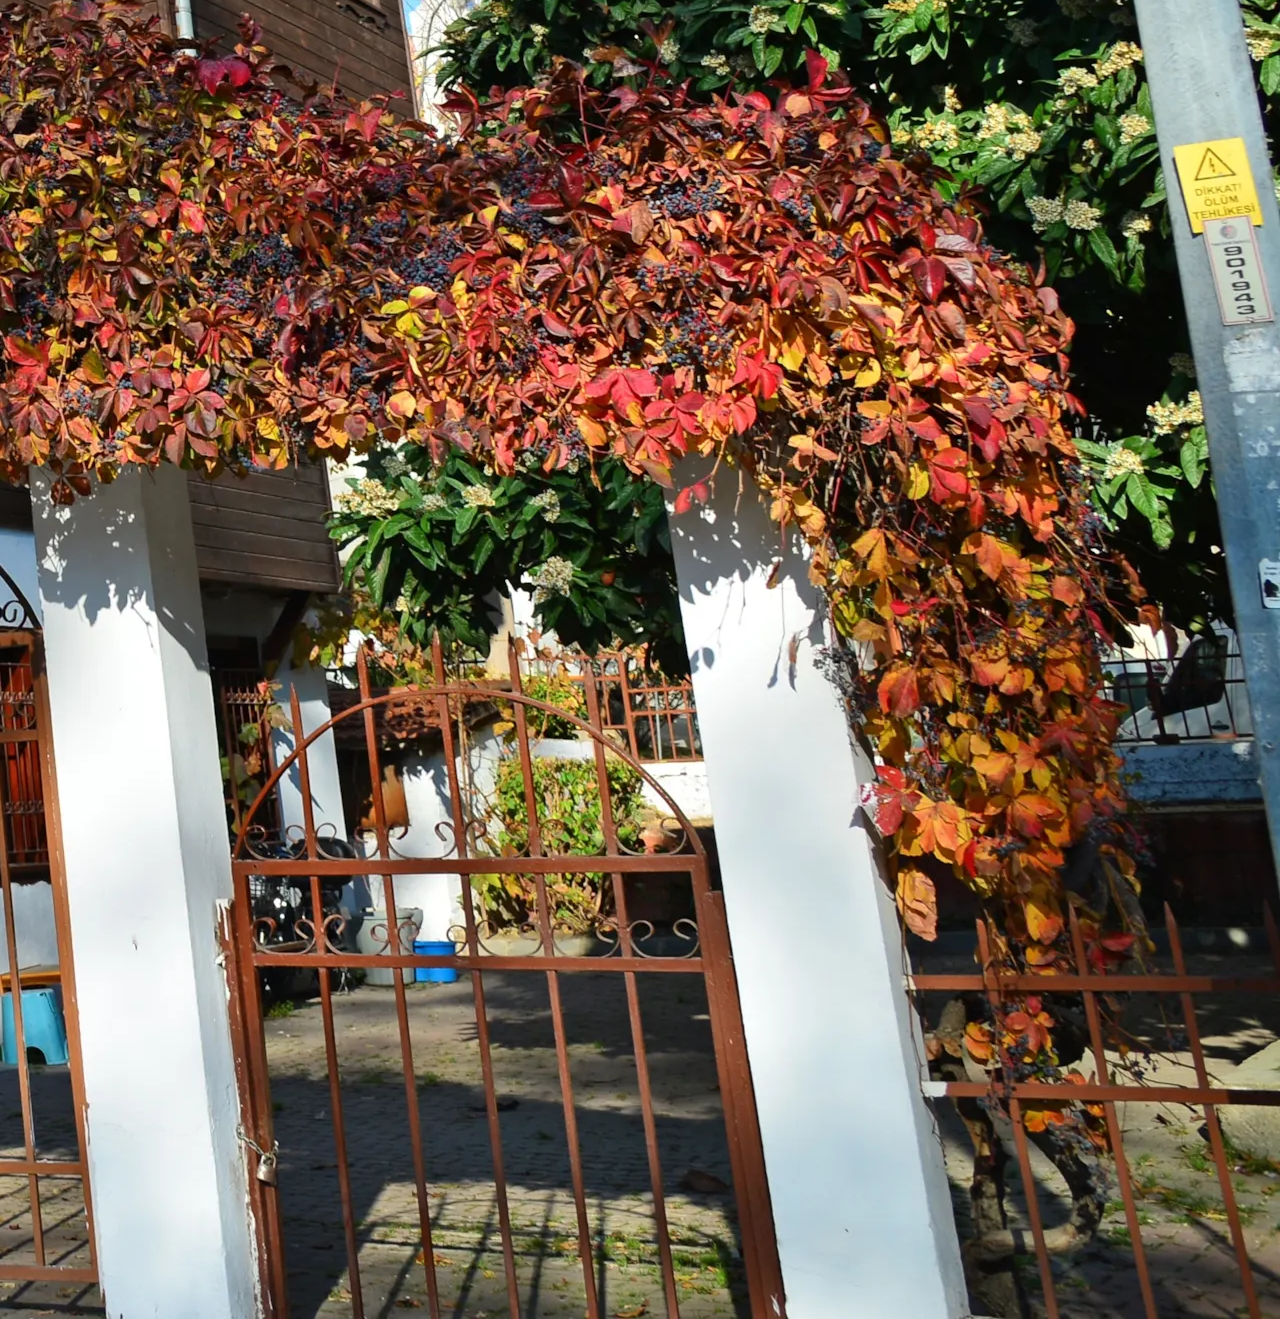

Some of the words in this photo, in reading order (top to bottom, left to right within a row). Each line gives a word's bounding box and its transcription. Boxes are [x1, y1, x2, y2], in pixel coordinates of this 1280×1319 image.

[1203, 195, 1239, 207] ÖLÜM
[1192, 203, 1256, 220] TEHLİKESİ
[1224, 246, 1256, 315] 901943
